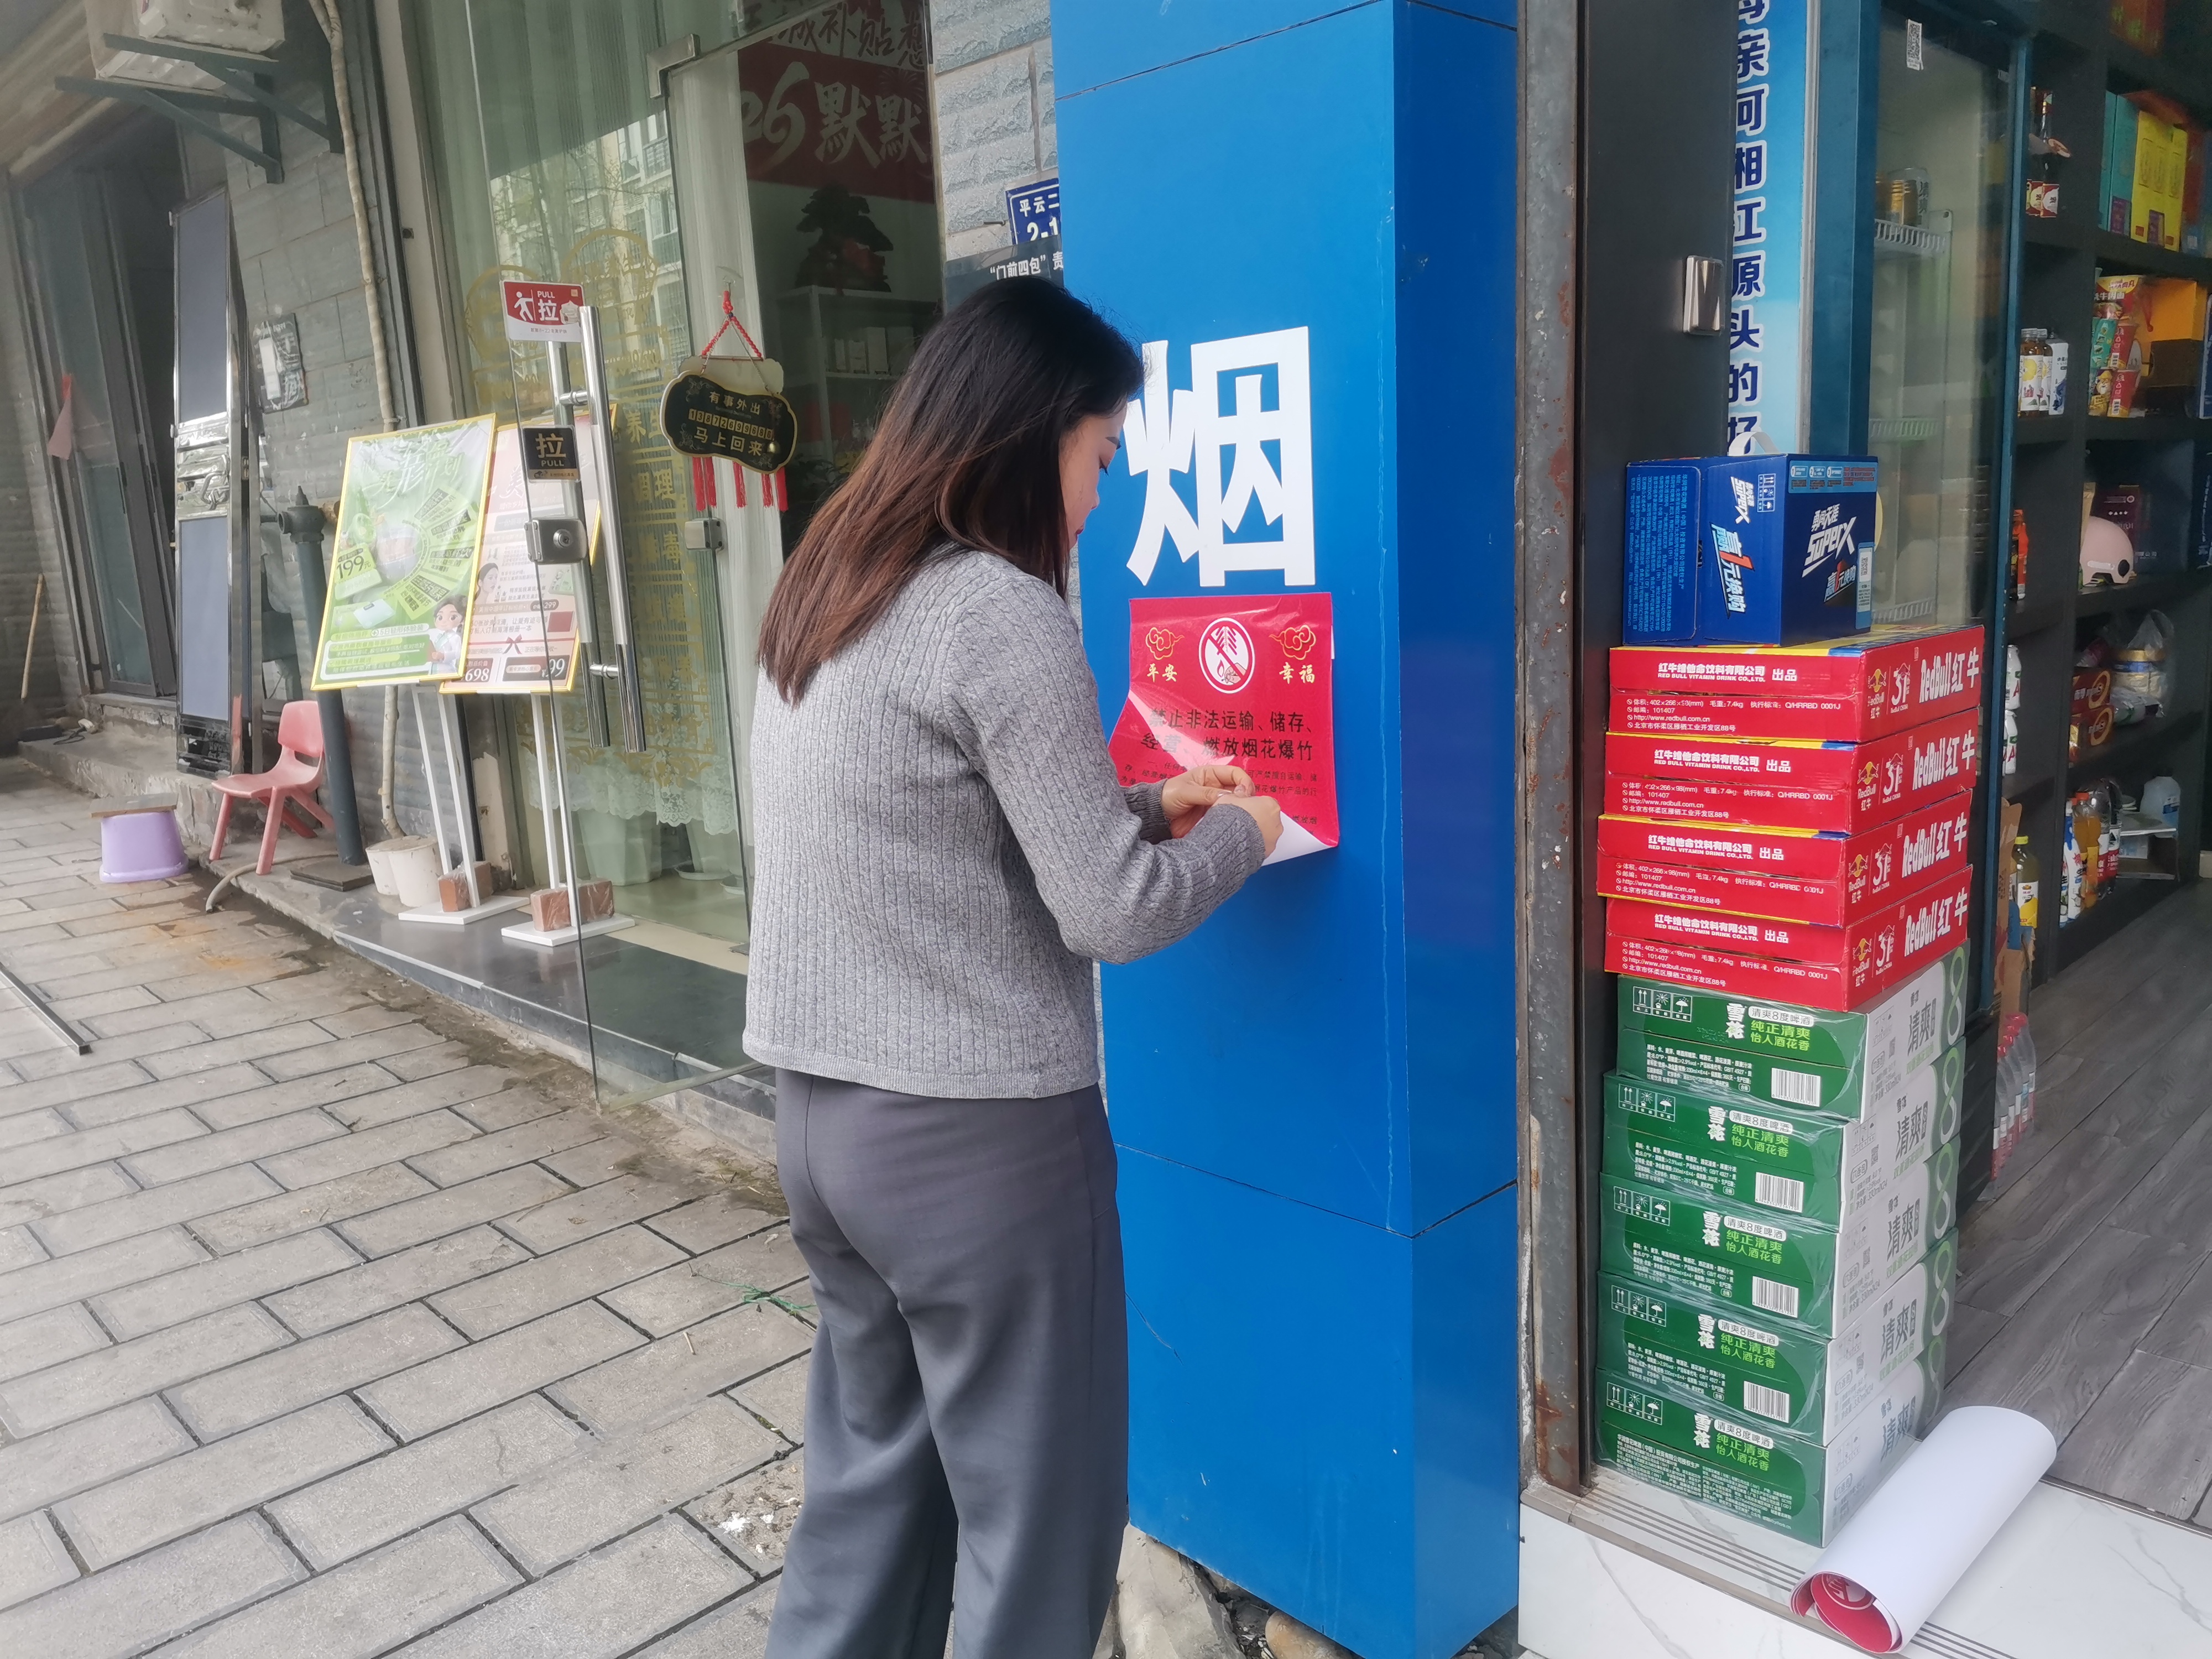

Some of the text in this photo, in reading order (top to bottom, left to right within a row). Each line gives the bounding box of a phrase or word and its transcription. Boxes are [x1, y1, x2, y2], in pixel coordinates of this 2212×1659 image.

[537, 290, 556, 299] PULL
[538, 299, 559, 321] 拉
[709, 392, 761, 415] 有事外出
[535, 433, 566, 458] 拉
[694, 426, 763, 456] 马上回来
[1123, 326, 1316, 587] 烟
[1146, 663, 1178, 682] 平安
[1279, 662, 1316, 684] 幸福
[1658, 663, 1797, 681] 红牛维他命饮料有限公司 出品
[1870, 707, 1880, 719] 红牛
[1654, 749, 1791, 773] 红牛维他命饮料有限公司 出品
[1858, 784, 1876, 799] RedBull
[1629, 798, 1704, 808] http://www.redbull.com.cn
[1861, 798, 1871, 811] 红牛
[1648, 835, 1784, 860] 红牛维他命饮料有限公司 出品
[1623, 879, 1695, 893] http://www.redbull.com.cn
[1848, 876, 1866, 892] RedBull
[1852, 890, 1861, 904] 红牛
[1655, 914, 1788, 943] 红牛维他命饮料有限公司 出品
[1855, 974, 1865, 987] 红牛
[1725, 1003, 1747, 1039] 雪花
[1751, 1008, 1810, 1025] 清爽8度啤酒
[1750, 1020, 1810, 1040] 纯正清爽
[1750, 1032, 1810, 1051] 怡人酒花香
[1708, 1106, 1726, 1141] 雪花
[1733, 1112, 1790, 1132] 清爽8度啤酒
[1731, 1124, 1788, 1146] 纯正清爽
[1731, 1136, 1788, 1157] 怡人酒花香
[1702, 1211, 1721, 1246] 雪花
[1728, 1217, 1783, 1239] 清爽8度啤酒
[1726, 1230, 1782, 1254] 纯正清爽
[1726, 1241, 1781, 1264] 怡人酒花香
[1698, 1313, 1715, 1349] 雪花
[1720, 1321, 1776, 1344] 清爽8度啤酒
[1720, 1333, 1776, 1357] 纯正清爽
[1720, 1344, 1775, 1369] 怡人酒花香
[1694, 1412, 1712, 1448] 雪花
[1717, 1421, 1770, 1446] 清爽8度啤酒
[1717, 1433, 1770, 1460] 纯正清爽
[1717, 1444, 1768, 1472] 怡人酒花香
